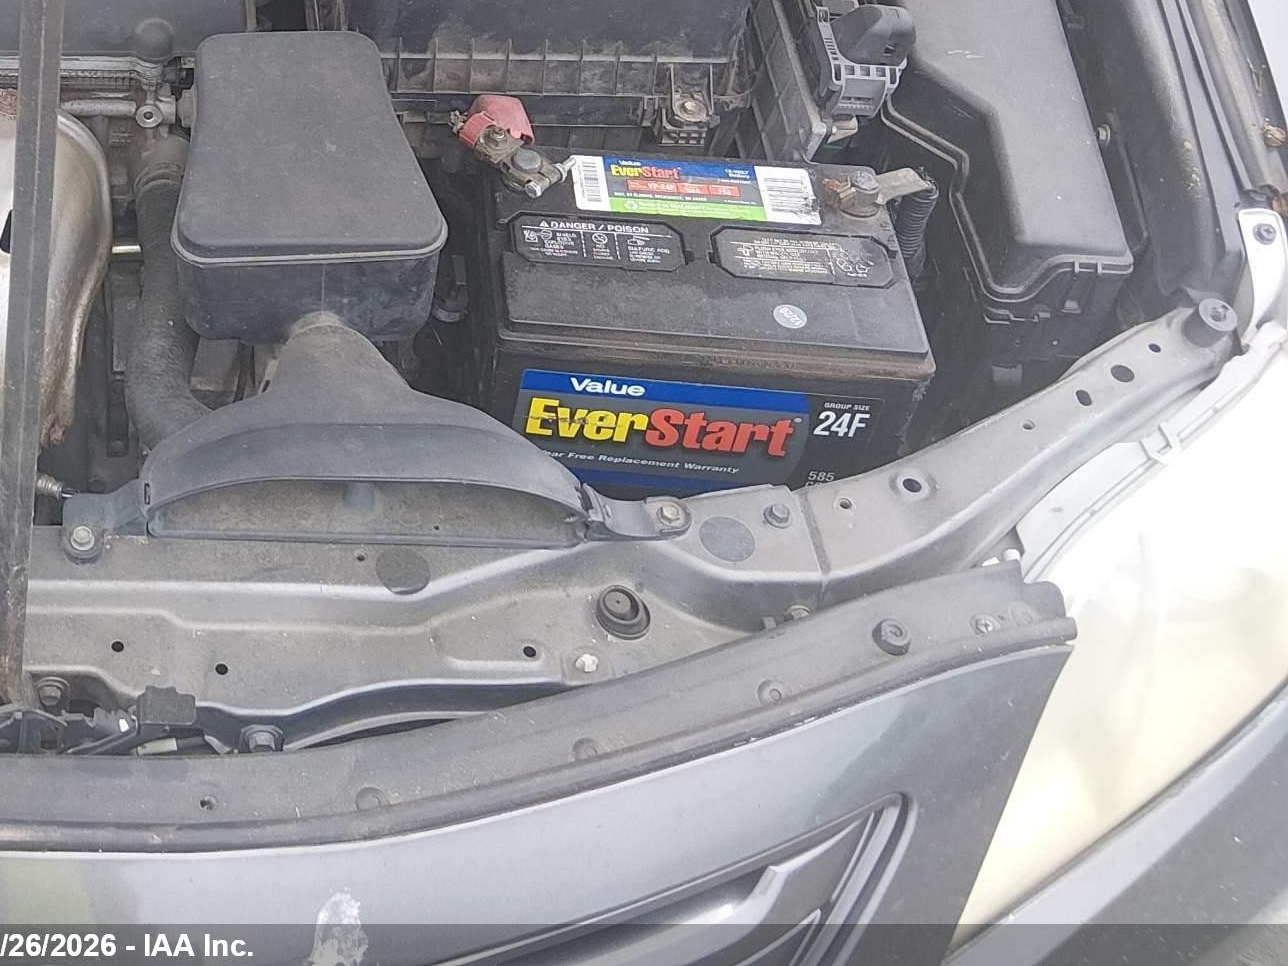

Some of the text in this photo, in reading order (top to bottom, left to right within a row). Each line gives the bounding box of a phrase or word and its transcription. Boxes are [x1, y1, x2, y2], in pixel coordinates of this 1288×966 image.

[610, 165, 680, 179] EverStart
[550, 221, 596, 231] DANGER
[607, 225, 649, 233] POISON
[570, 377, 646, 397] Value
[824, 402, 852, 410] GROUP
[525, 397, 796, 457] EverStart
[813, 410, 871, 438] 24F
[567, 452, 595, 461] Free
[598, 455, 680, 468] Replacement
[683, 462, 739, 475] Warranty
[807, 471, 835, 482] 585
